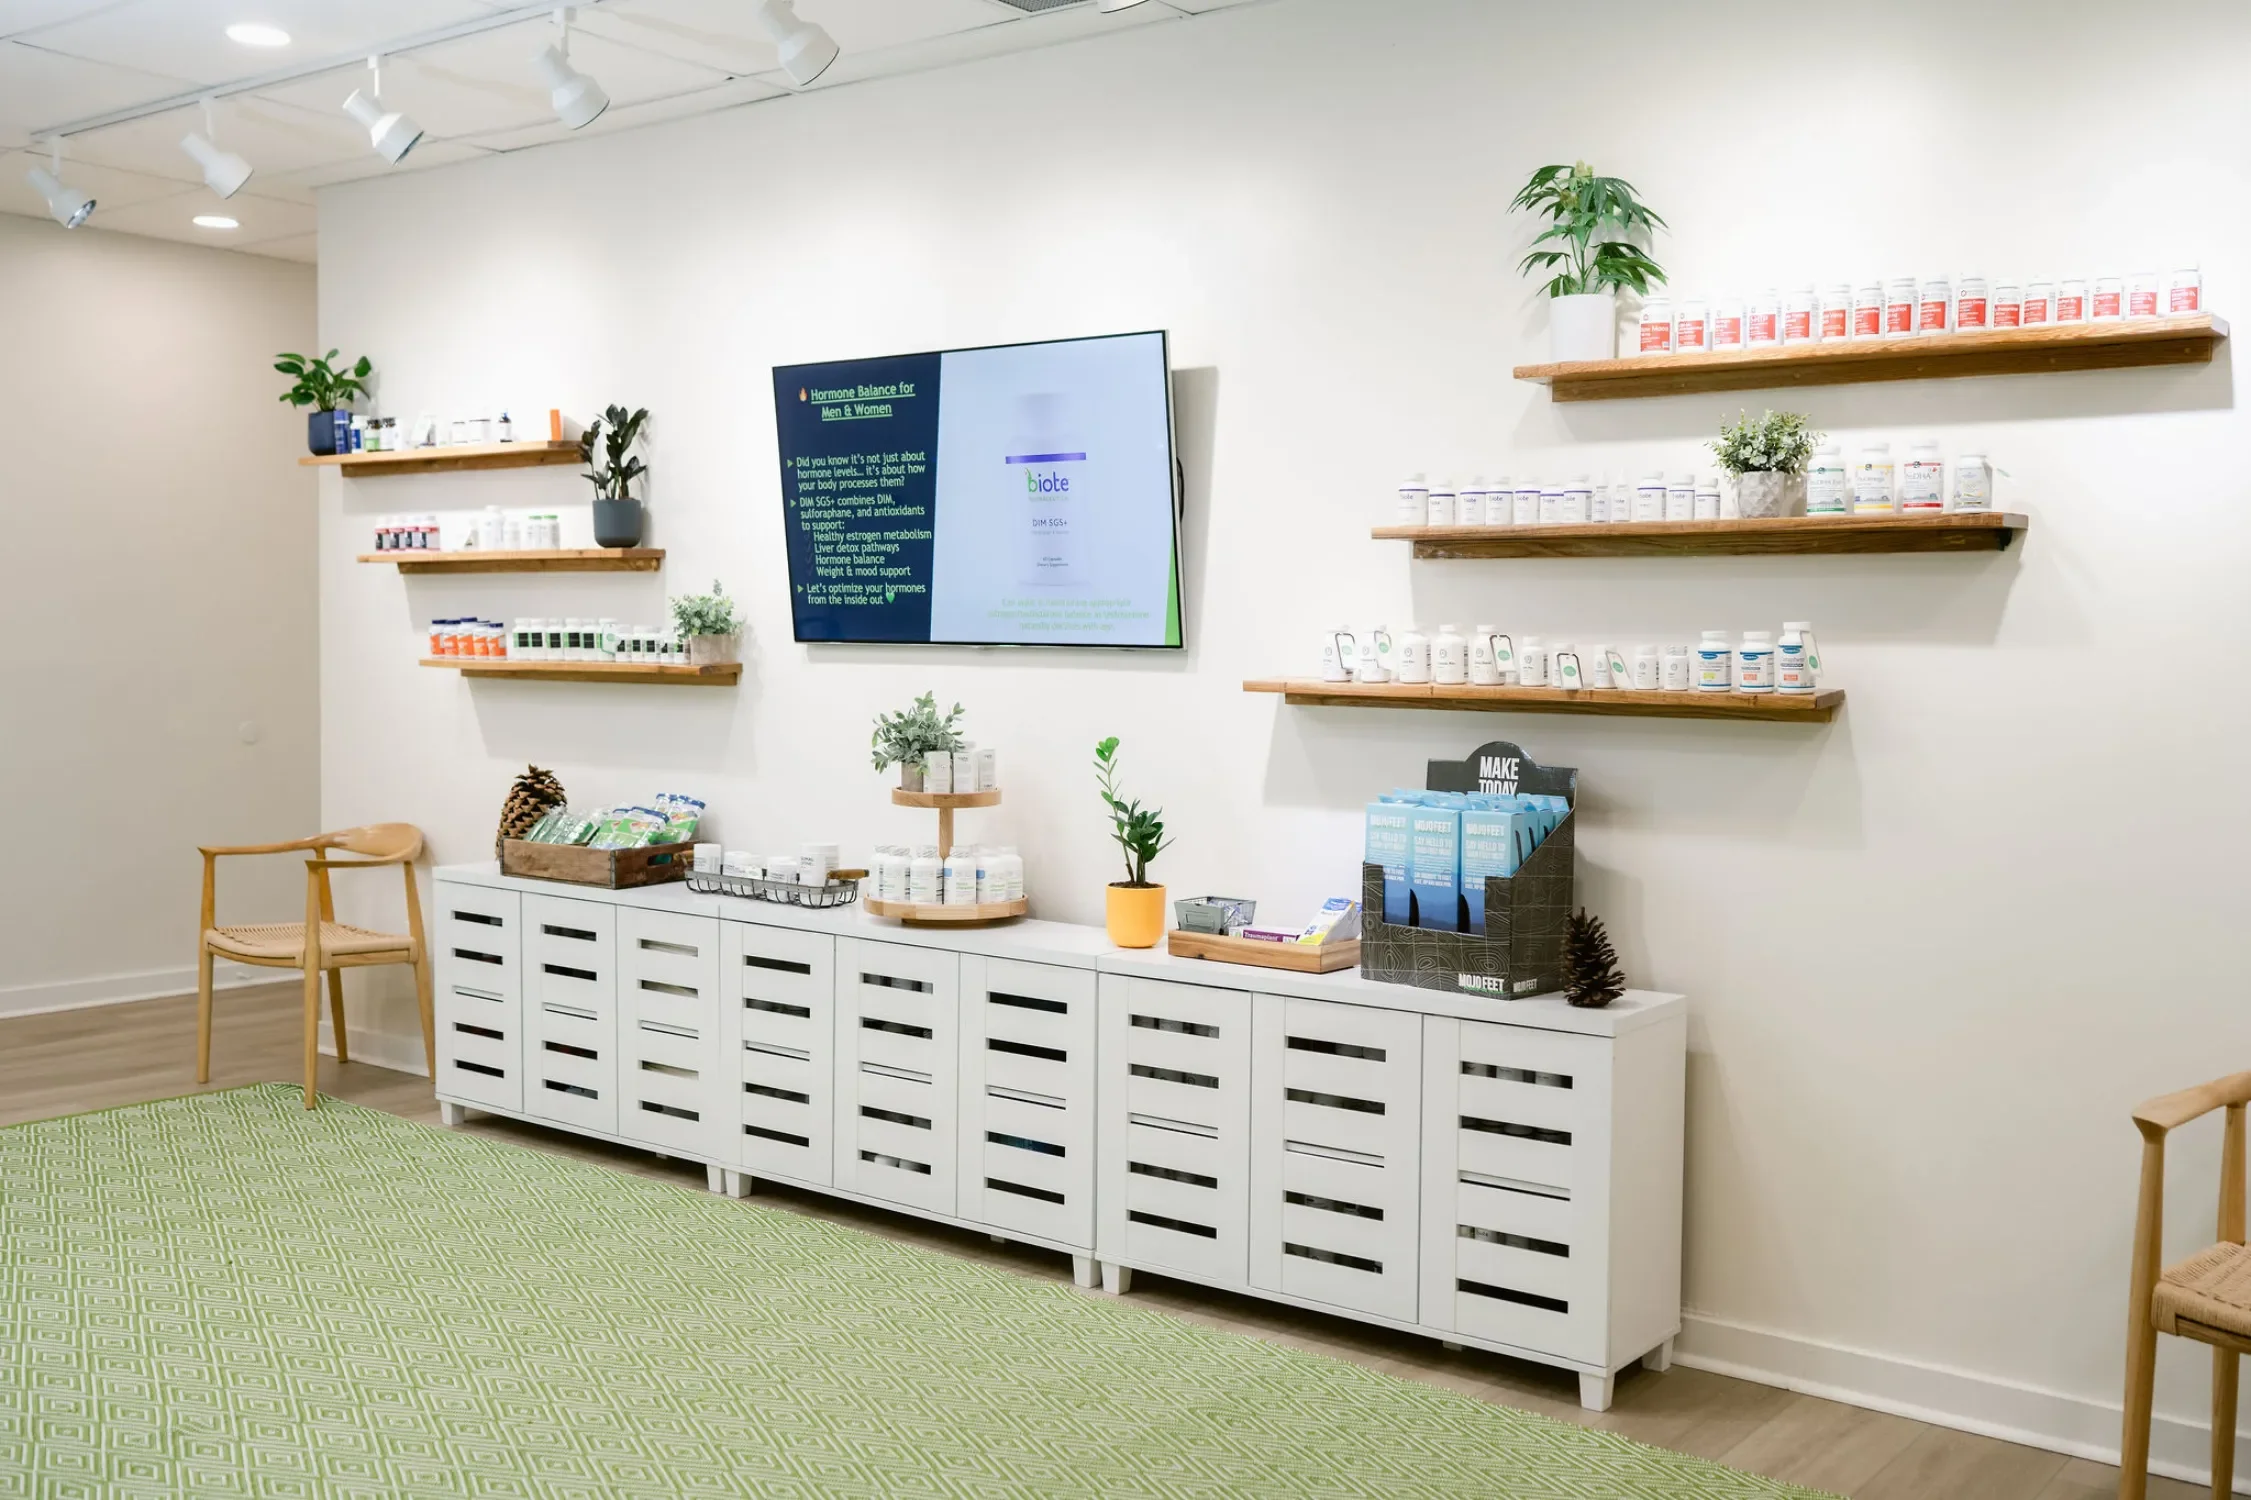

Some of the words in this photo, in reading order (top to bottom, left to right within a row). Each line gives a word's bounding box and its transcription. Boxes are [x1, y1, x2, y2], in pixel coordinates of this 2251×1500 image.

[811, 388, 855, 401] Hormone
[857, 385, 896, 398] Balance
[900, 382, 914, 395] for
[822, 406, 842, 419] Men
[845, 405, 852, 416] &
[854, 402, 891, 415] Women
[797, 456, 810, 467] Did
[811, 458, 826, 468] you
[828, 455, 849, 466] know
[851, 454, 864, 464] it's
[866, 453, 880, 463] not
[883, 453, 899, 465] just
[901, 452, 925, 462] about
[798, 468, 831, 479] hormone
[866, 465, 880, 475] it's
[882, 464, 905, 475] about
[908, 463, 925, 473] how
[798, 481, 815, 492] your
[818, 479, 837, 491] body
[840, 479, 878, 490] processes
[880, 477, 905, 487] them?
[1025, 468, 1069, 492] biote
[800, 497, 814, 508] DIM
[816, 497, 835, 507] SGS+
[837, 495, 875, 506] combines
[877, 494, 895, 505] DIM,
[801, 508, 854, 521] sulforaphane,
[857, 507, 872, 516] and
[874, 505, 925, 516] antioxidants
[802, 522, 810, 530] to
[812, 520, 844, 532] support:
[814, 532, 844, 544] Healthy
[846, 532, 881, 542] estrogen
[883, 529, 931, 540] metabolism
[814, 543, 834, 553] Liver
[837, 543, 859, 553] detox
[862, 542, 899, 554] pathways
[816, 555, 851, 565] Hormone
[854, 554, 885, 564] balance
[817, 566, 843, 578] Weight
[846, 566, 852, 576] &
[855, 566, 877, 576] mood
[880, 566, 911, 578] support
[807, 584, 826, 593] Let's
[829, 583, 863, 595] optimize
[865, 584, 883, 594] your
[886, 582, 925, 593] hormones
[808, 595, 826, 604] from
[829, 594, 842, 604] the
[844, 594, 868, 604] inside
[870, 595, 883, 604] out
[1480, 755, 1520, 780] MAKE
[1479, 779, 1518, 796] TODAY
[1244, 932, 1278, 941] Traumaplant
